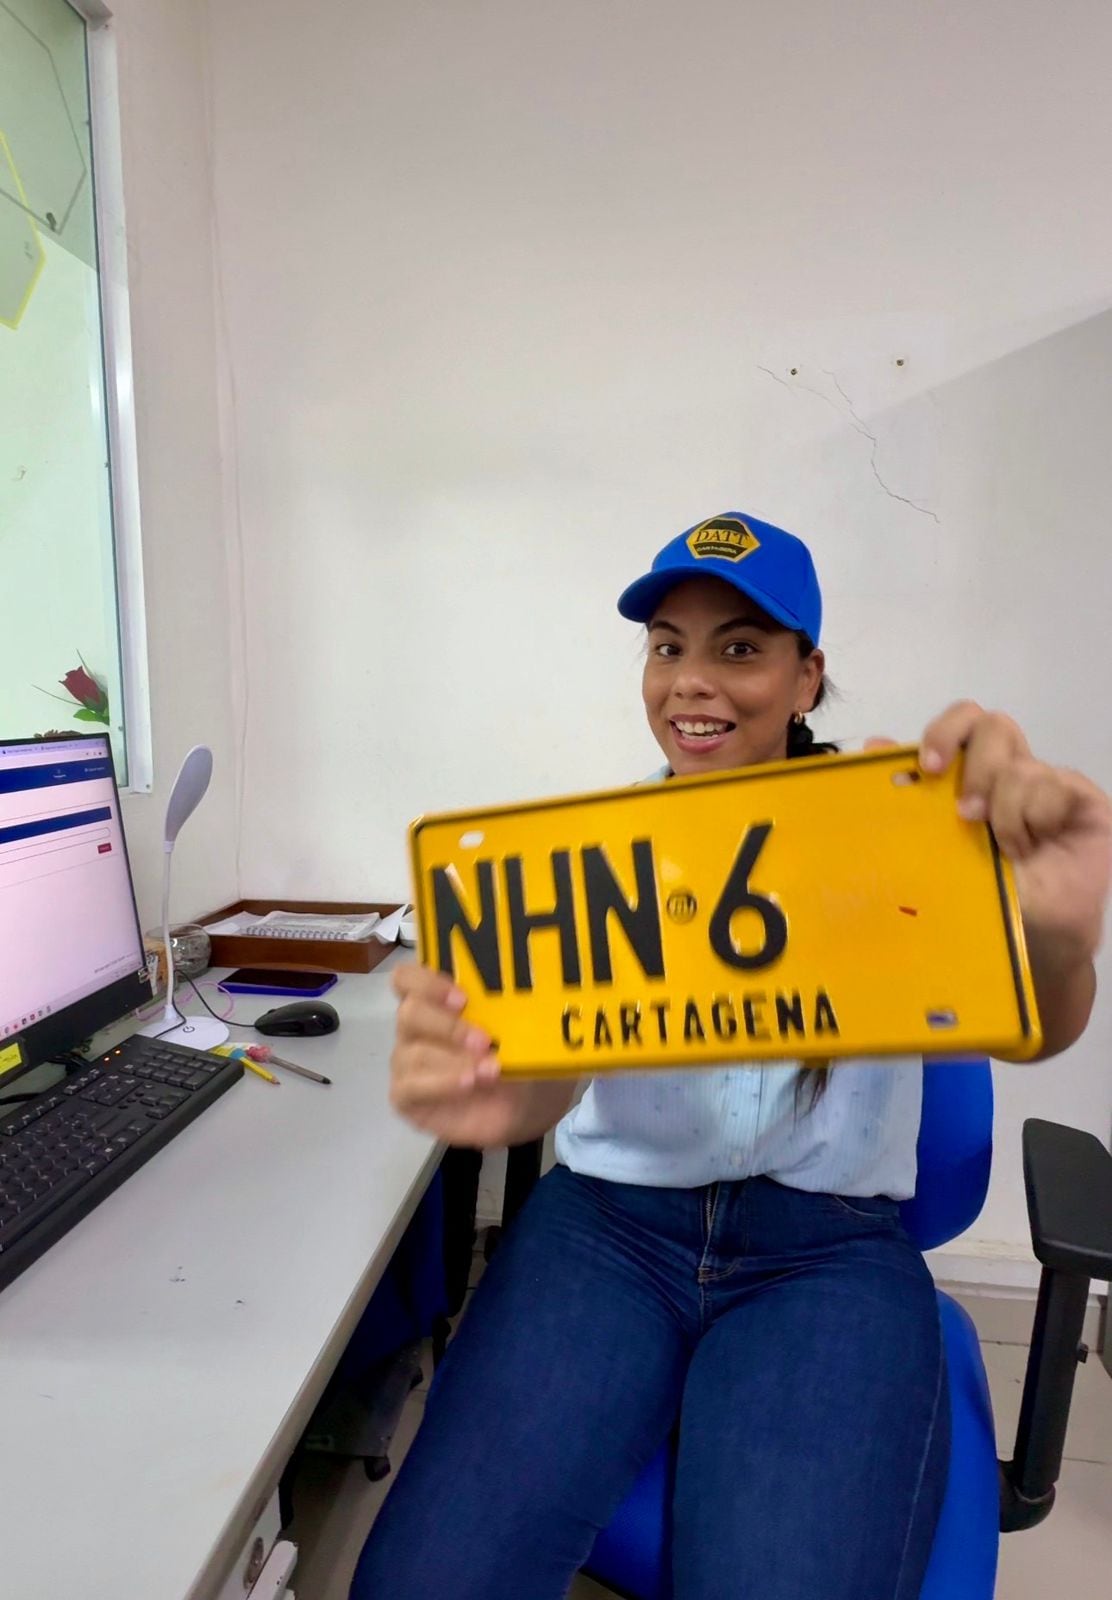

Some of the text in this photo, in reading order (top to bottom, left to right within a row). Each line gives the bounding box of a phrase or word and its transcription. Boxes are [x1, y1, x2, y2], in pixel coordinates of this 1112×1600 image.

[696, 530, 749, 545] DATT
[430, 819, 788, 994] NHN 6
[561, 987, 840, 1050] CARTAGENA
